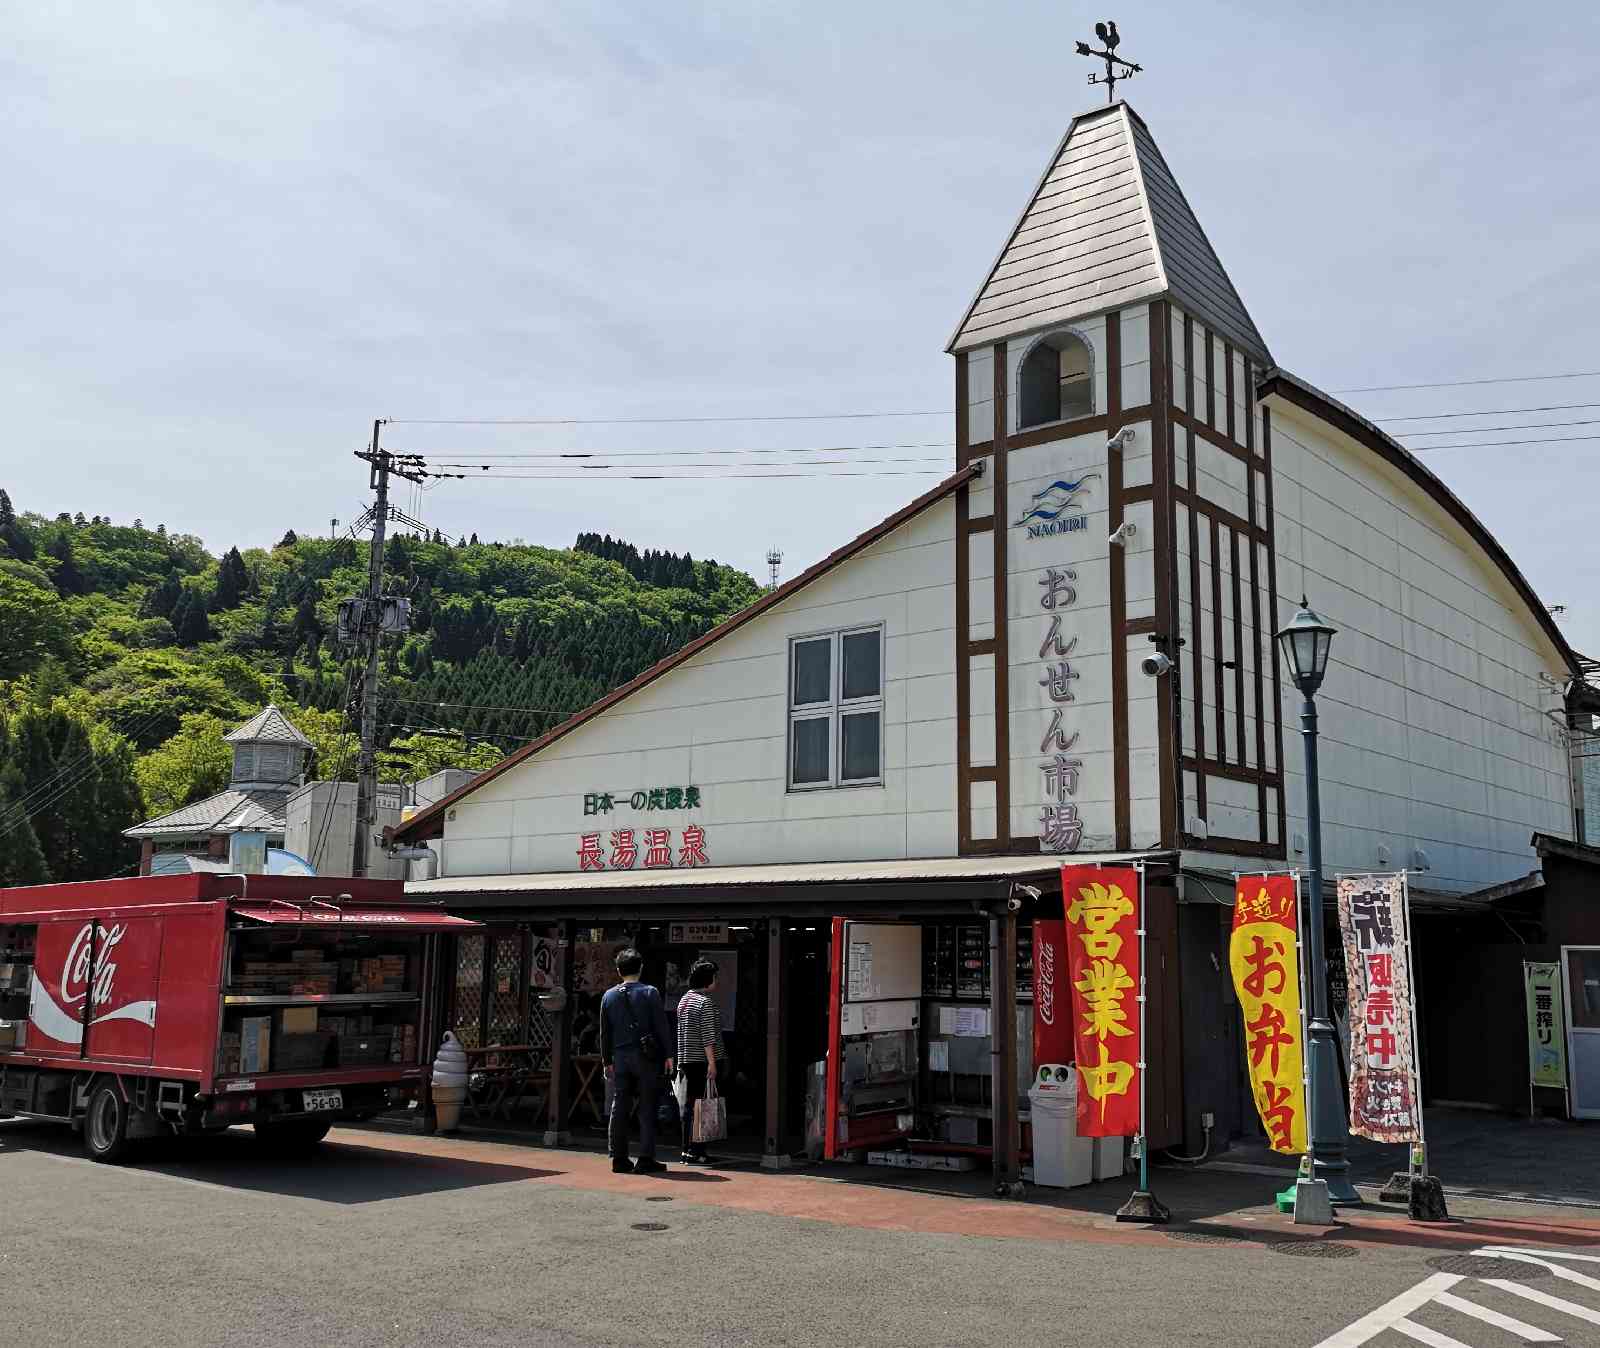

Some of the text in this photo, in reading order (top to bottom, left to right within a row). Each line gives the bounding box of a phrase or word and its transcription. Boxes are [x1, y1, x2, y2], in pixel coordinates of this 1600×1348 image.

[1038, 567, 1083, 852] おんせん市場
[576, 822, 708, 871] 長湯温泉
[583, 786, 700, 816] 日本一の炭酸泉
[1065, 880, 1136, 1126] 営業中
[1241, 934, 1296, 1152] お弁当
[1535, 985, 1553, 1046] 一番搾り
